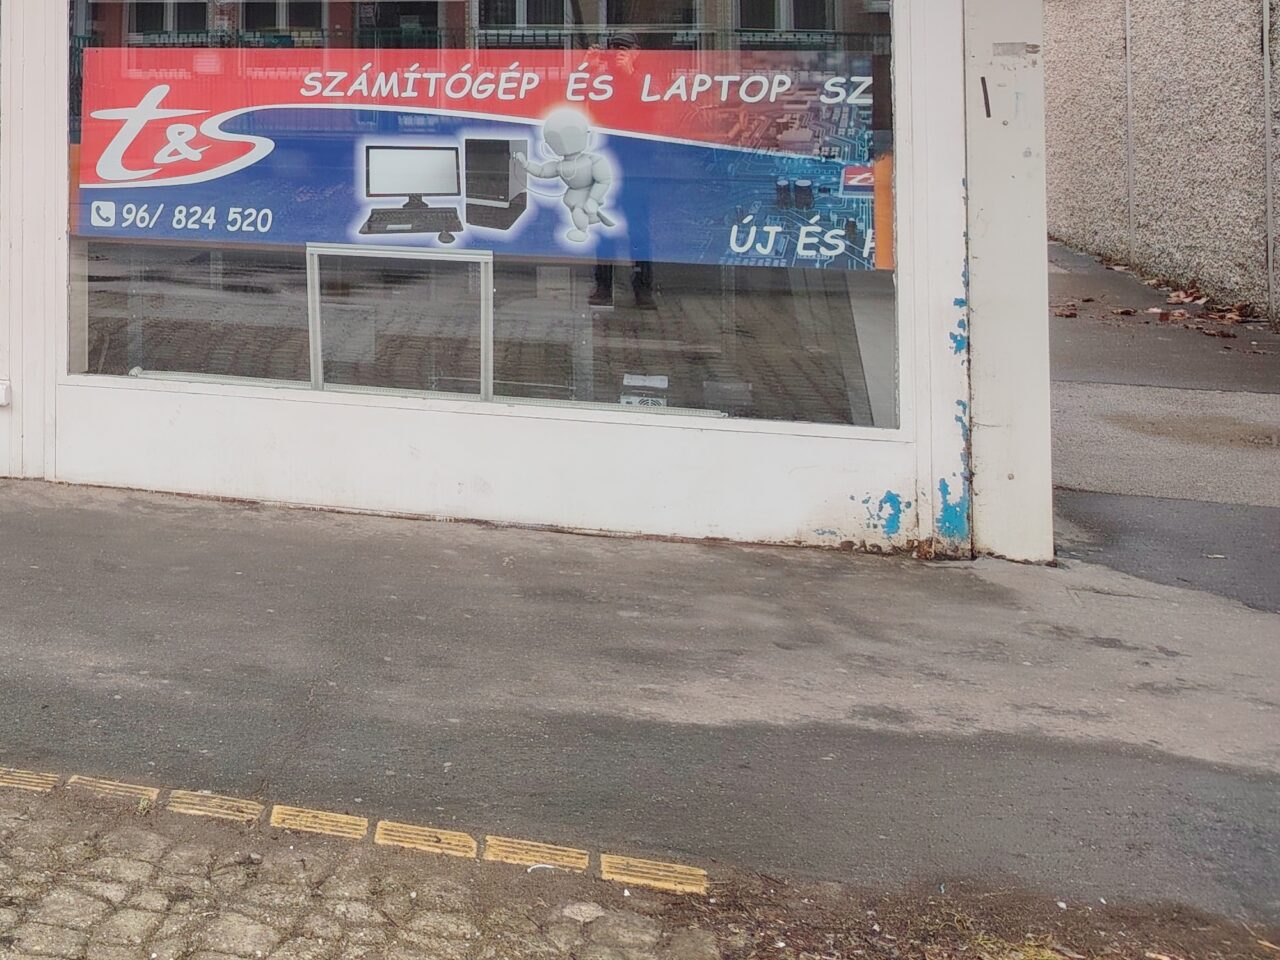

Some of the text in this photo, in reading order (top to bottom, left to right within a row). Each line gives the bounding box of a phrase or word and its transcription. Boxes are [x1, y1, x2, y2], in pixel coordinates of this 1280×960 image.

[300, 61, 874, 105] SZÁMÍTÓGÉP ÉS LAPTOP SZ
[121, 203, 274, 233] 96/ 824 520
[729, 215, 783, 255] ÚJ
[796, 214, 846, 257] ÉS
